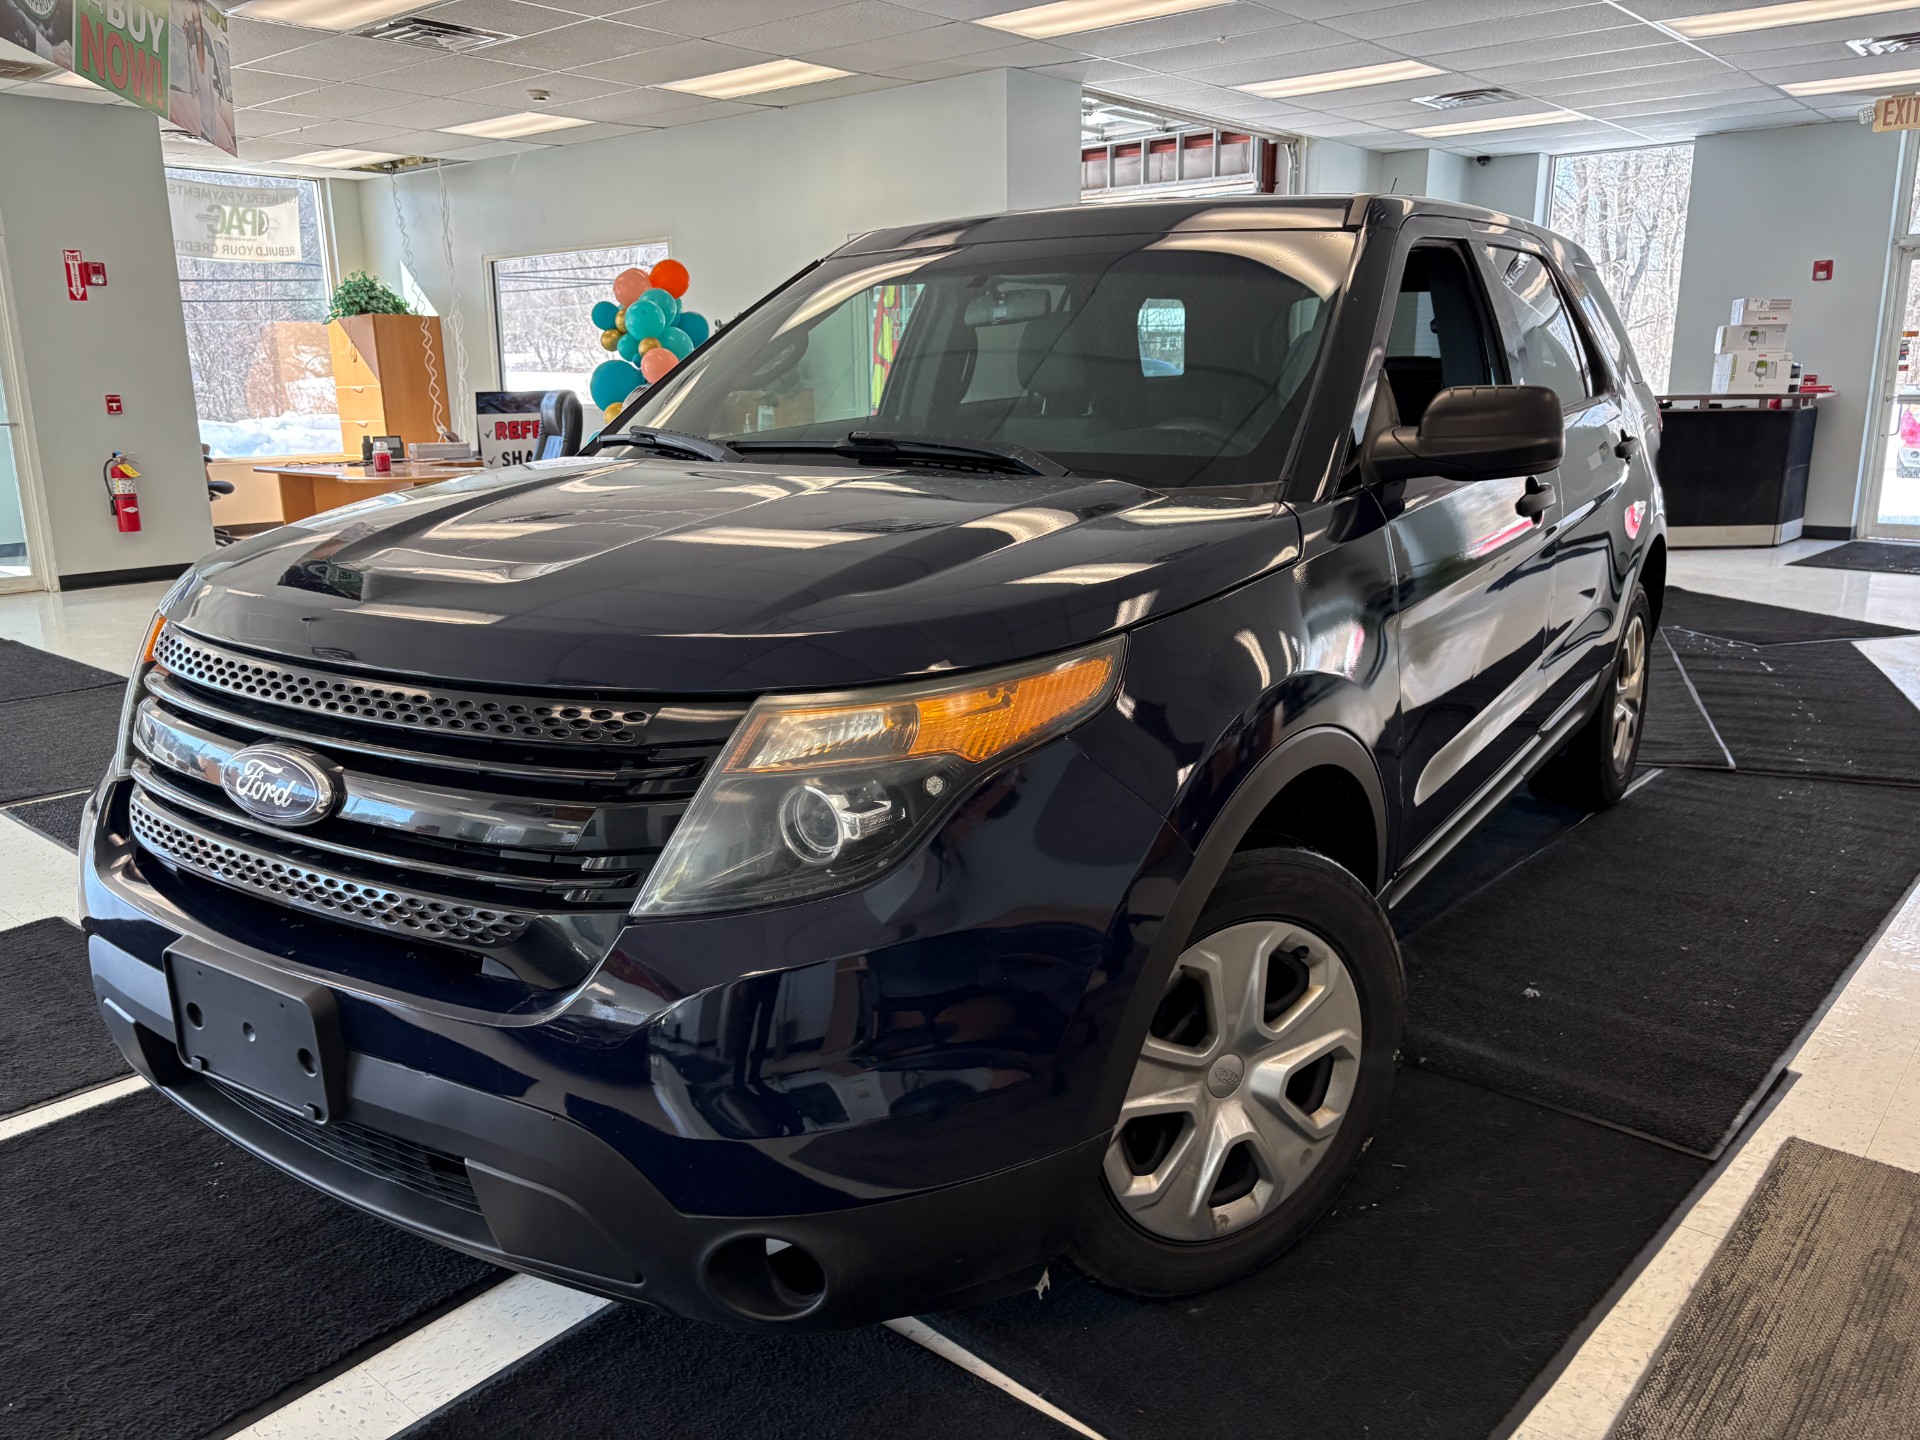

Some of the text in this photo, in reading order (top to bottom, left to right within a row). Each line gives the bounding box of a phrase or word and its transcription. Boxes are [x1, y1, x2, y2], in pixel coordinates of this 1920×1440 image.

[107, 0, 164, 54] BUY
[80, 12, 164, 111] NOW!
[1883, 97, 1920, 126] EXIT
[66, 254, 79, 262] FIRE
[235, 759, 297, 808] Ford
